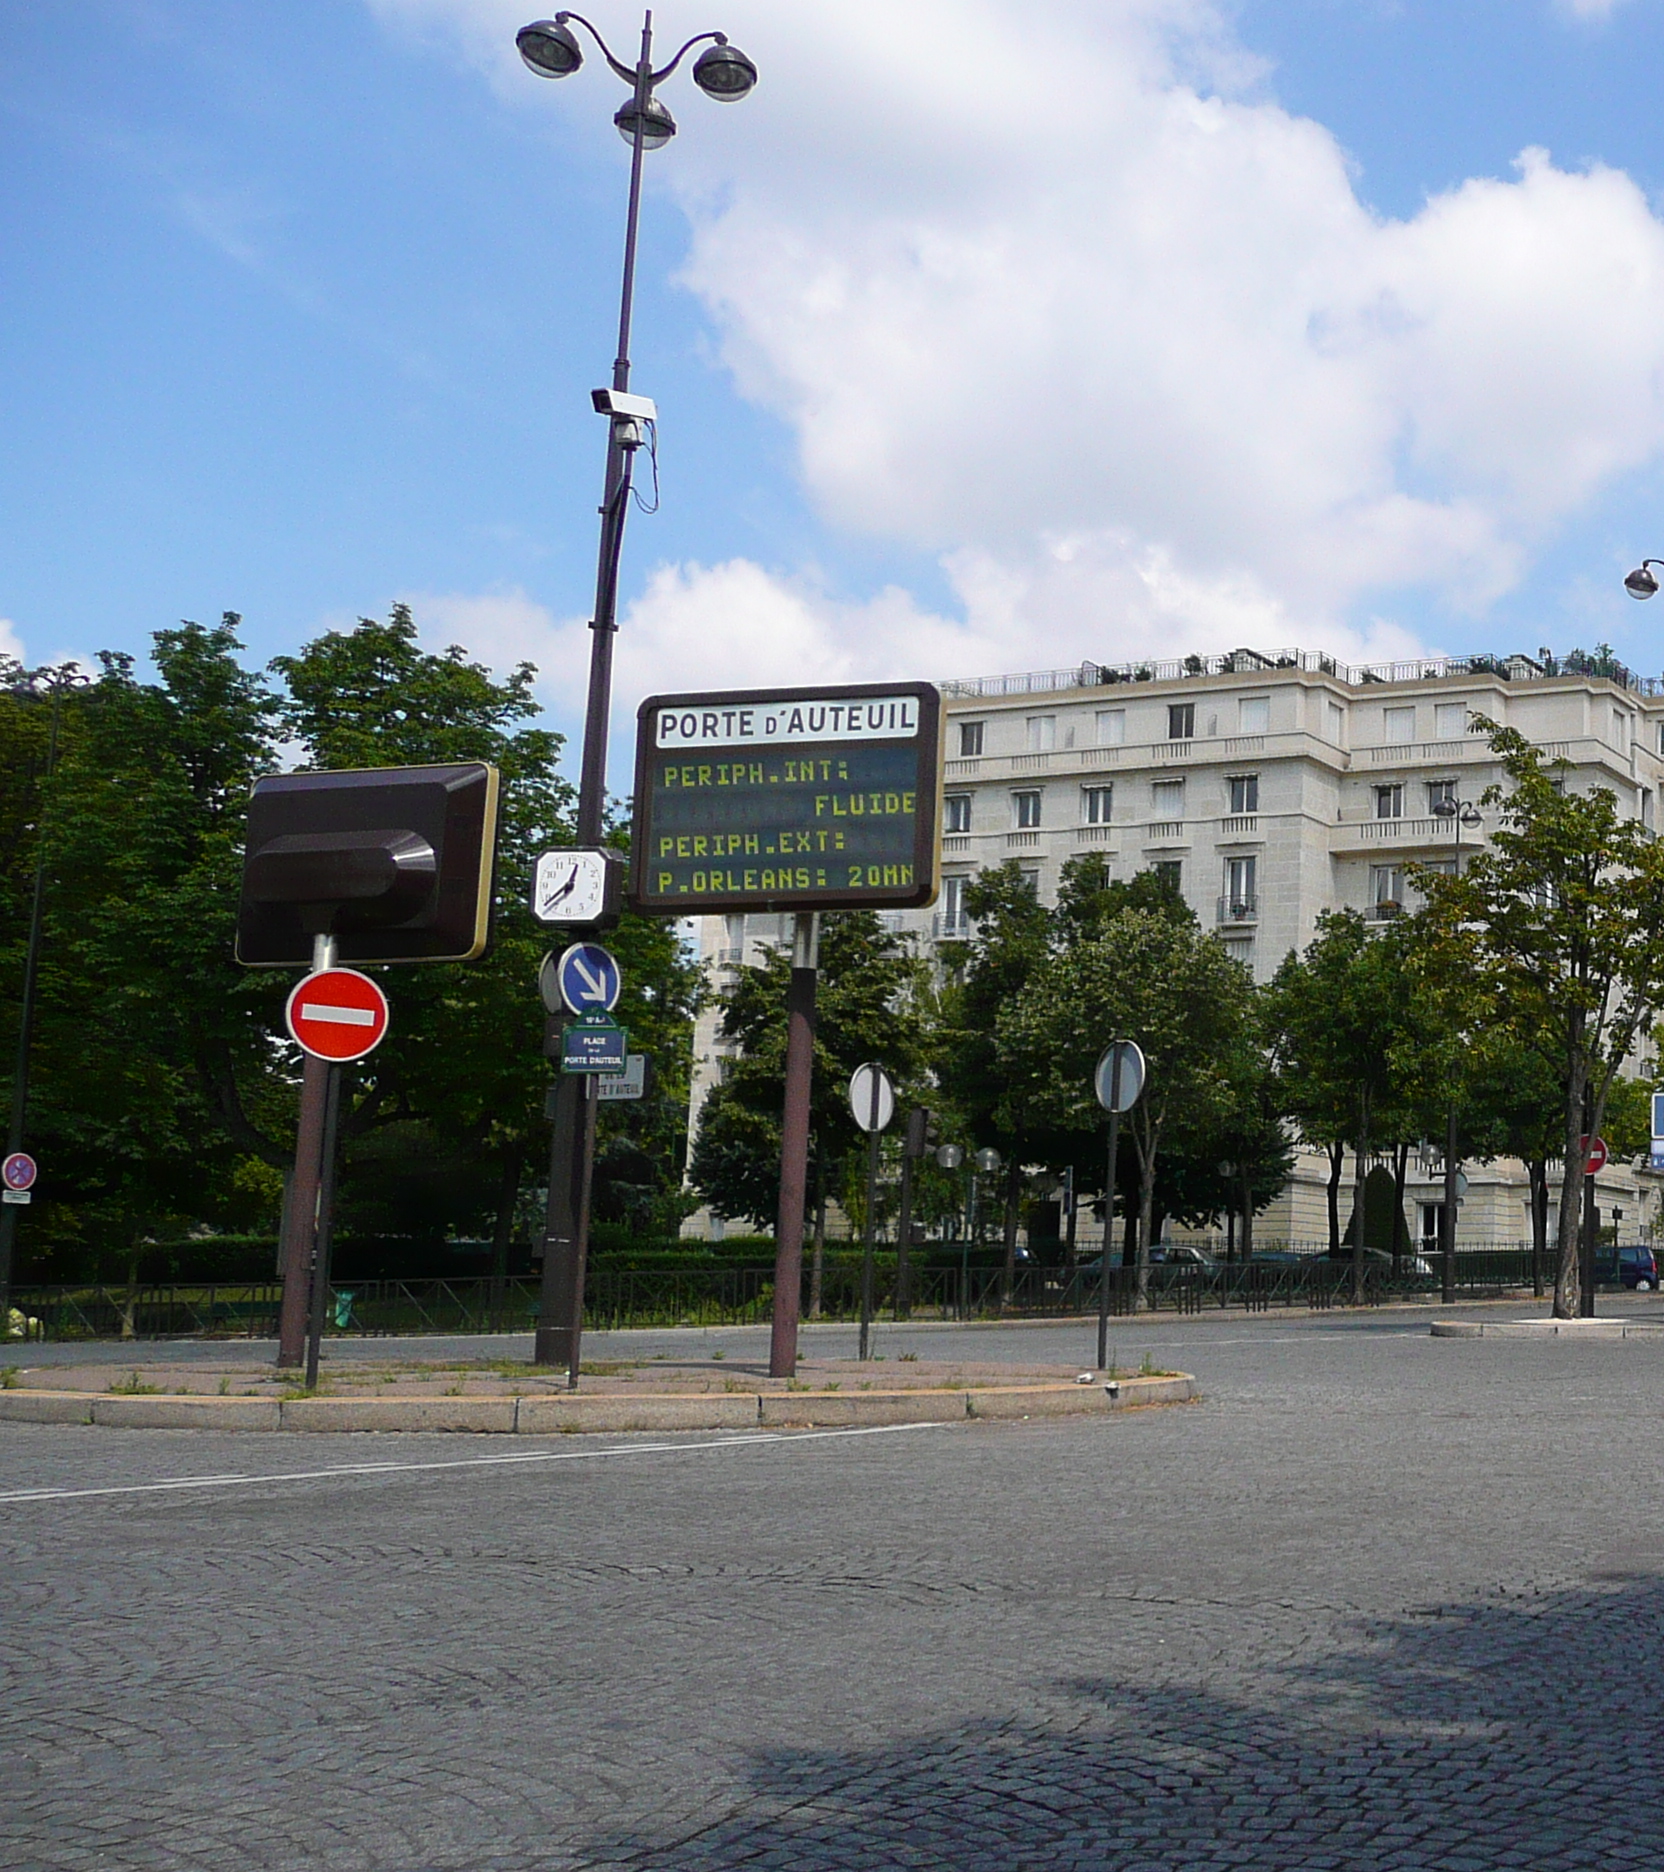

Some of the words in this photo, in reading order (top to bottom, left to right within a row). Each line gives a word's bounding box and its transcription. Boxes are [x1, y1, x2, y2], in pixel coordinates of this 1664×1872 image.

[660, 710, 754, 739] PORTE
[815, 792, 916, 817] FLUIDE
[659, 830, 845, 858] PERIPH.EXT:
[658, 868, 827, 893] P.ORLEANS:
[848, 864, 914, 888] 20MN
